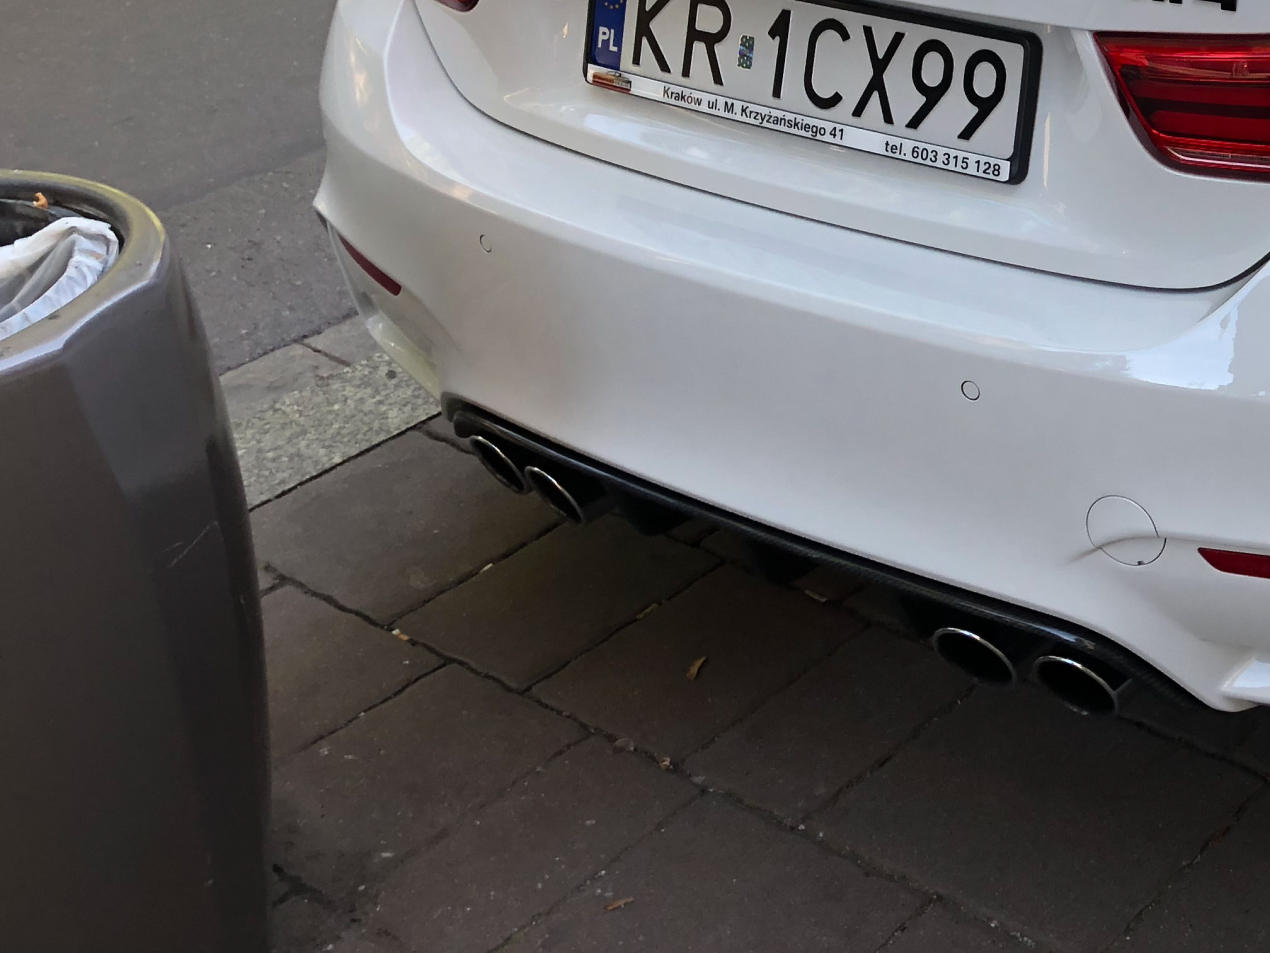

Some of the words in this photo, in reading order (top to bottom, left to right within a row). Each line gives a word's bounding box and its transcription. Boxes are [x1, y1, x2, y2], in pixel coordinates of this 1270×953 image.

[597, 26, 618, 52] PL
[662, 85, 702, 108] Kraków
[707, 98, 720, 111] ul.
[723, 101, 737, 115] M.
[740, 104, 826, 137] Krzyżańskiego
[829, 126, 844, 141] 41
[884, 140, 907, 157] tel.
[911, 145, 938, 163] 603
[942, 153, 970, 170] 315
[974, 159, 1001, 177] 128
